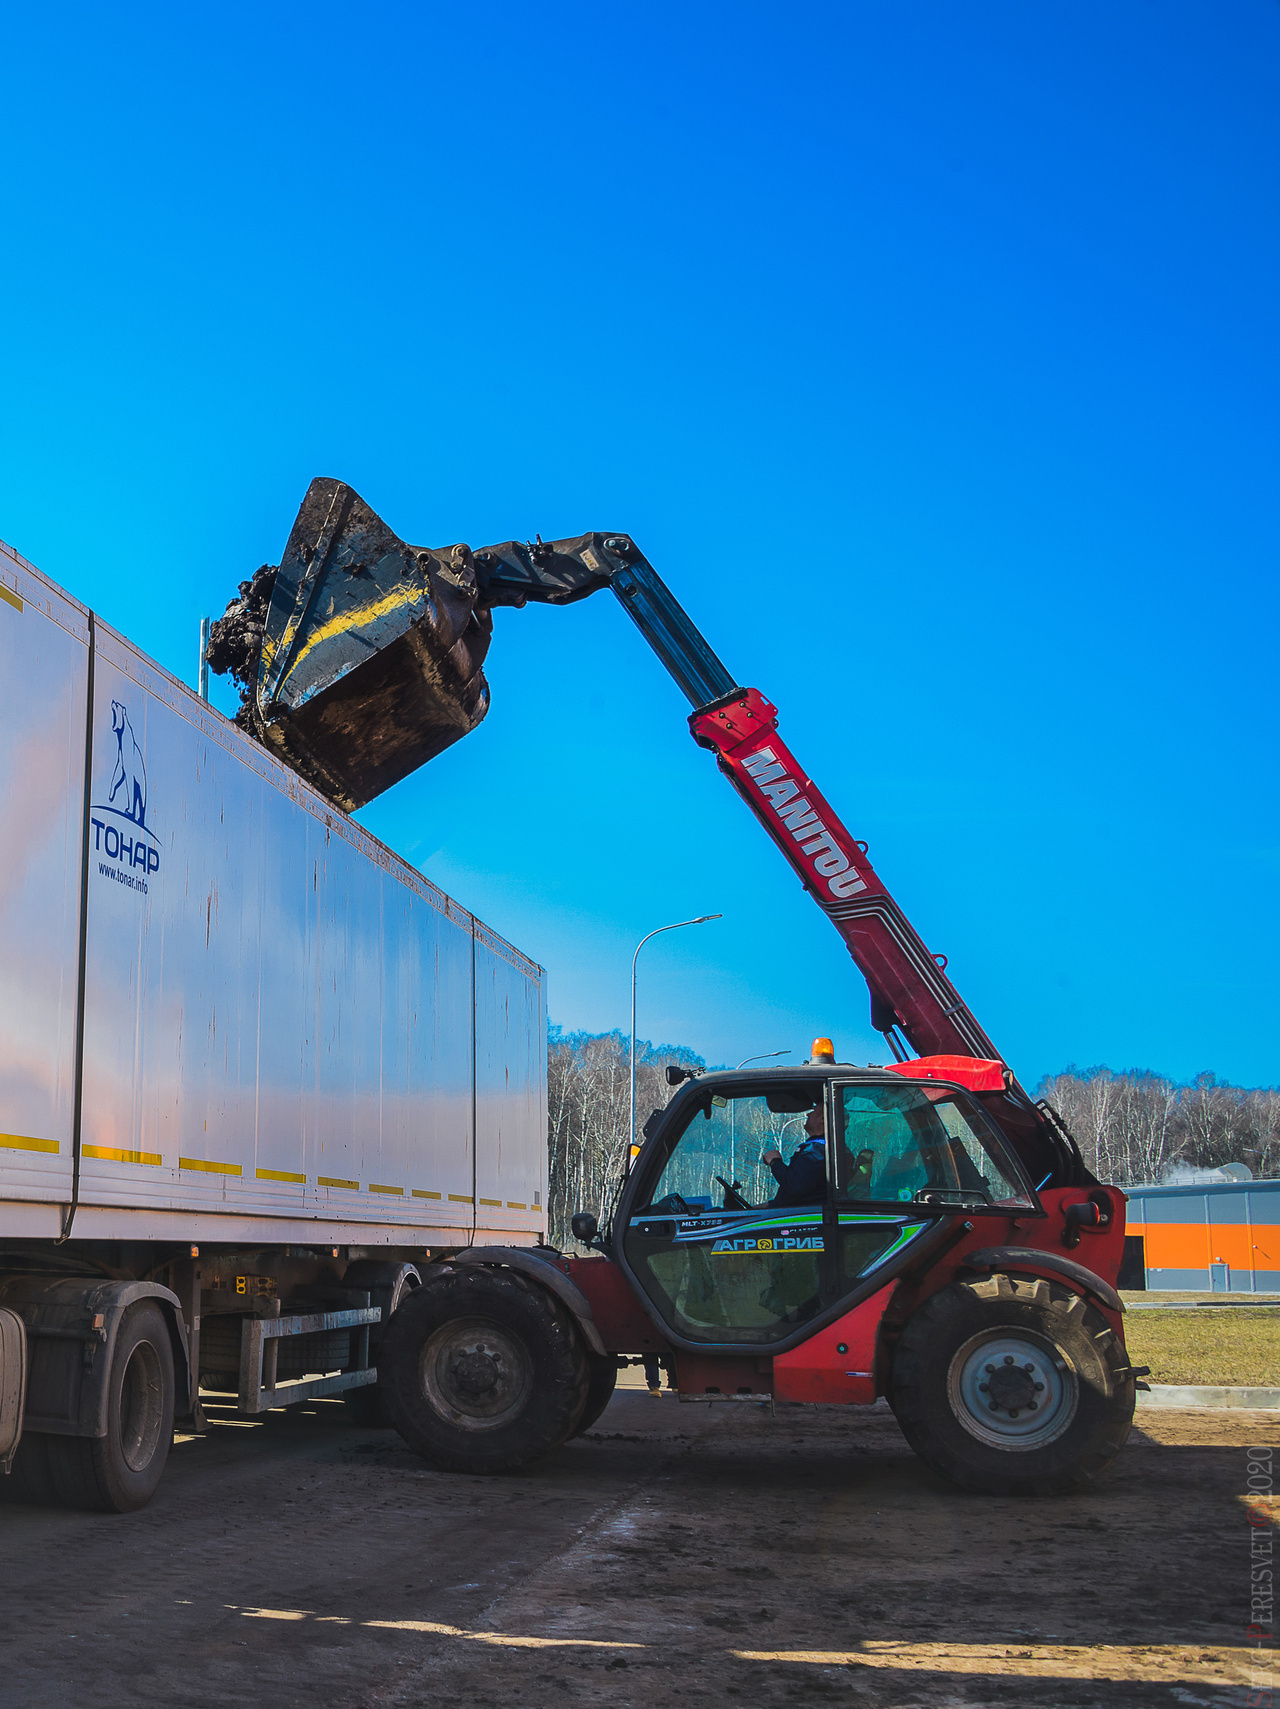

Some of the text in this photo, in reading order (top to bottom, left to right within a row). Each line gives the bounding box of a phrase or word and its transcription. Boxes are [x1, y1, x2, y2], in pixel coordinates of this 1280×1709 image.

[91, 817, 160, 875] ТОНАР
[740, 745, 869, 898] MANITOU
[98, 862, 149, 895] www.tonar.info
